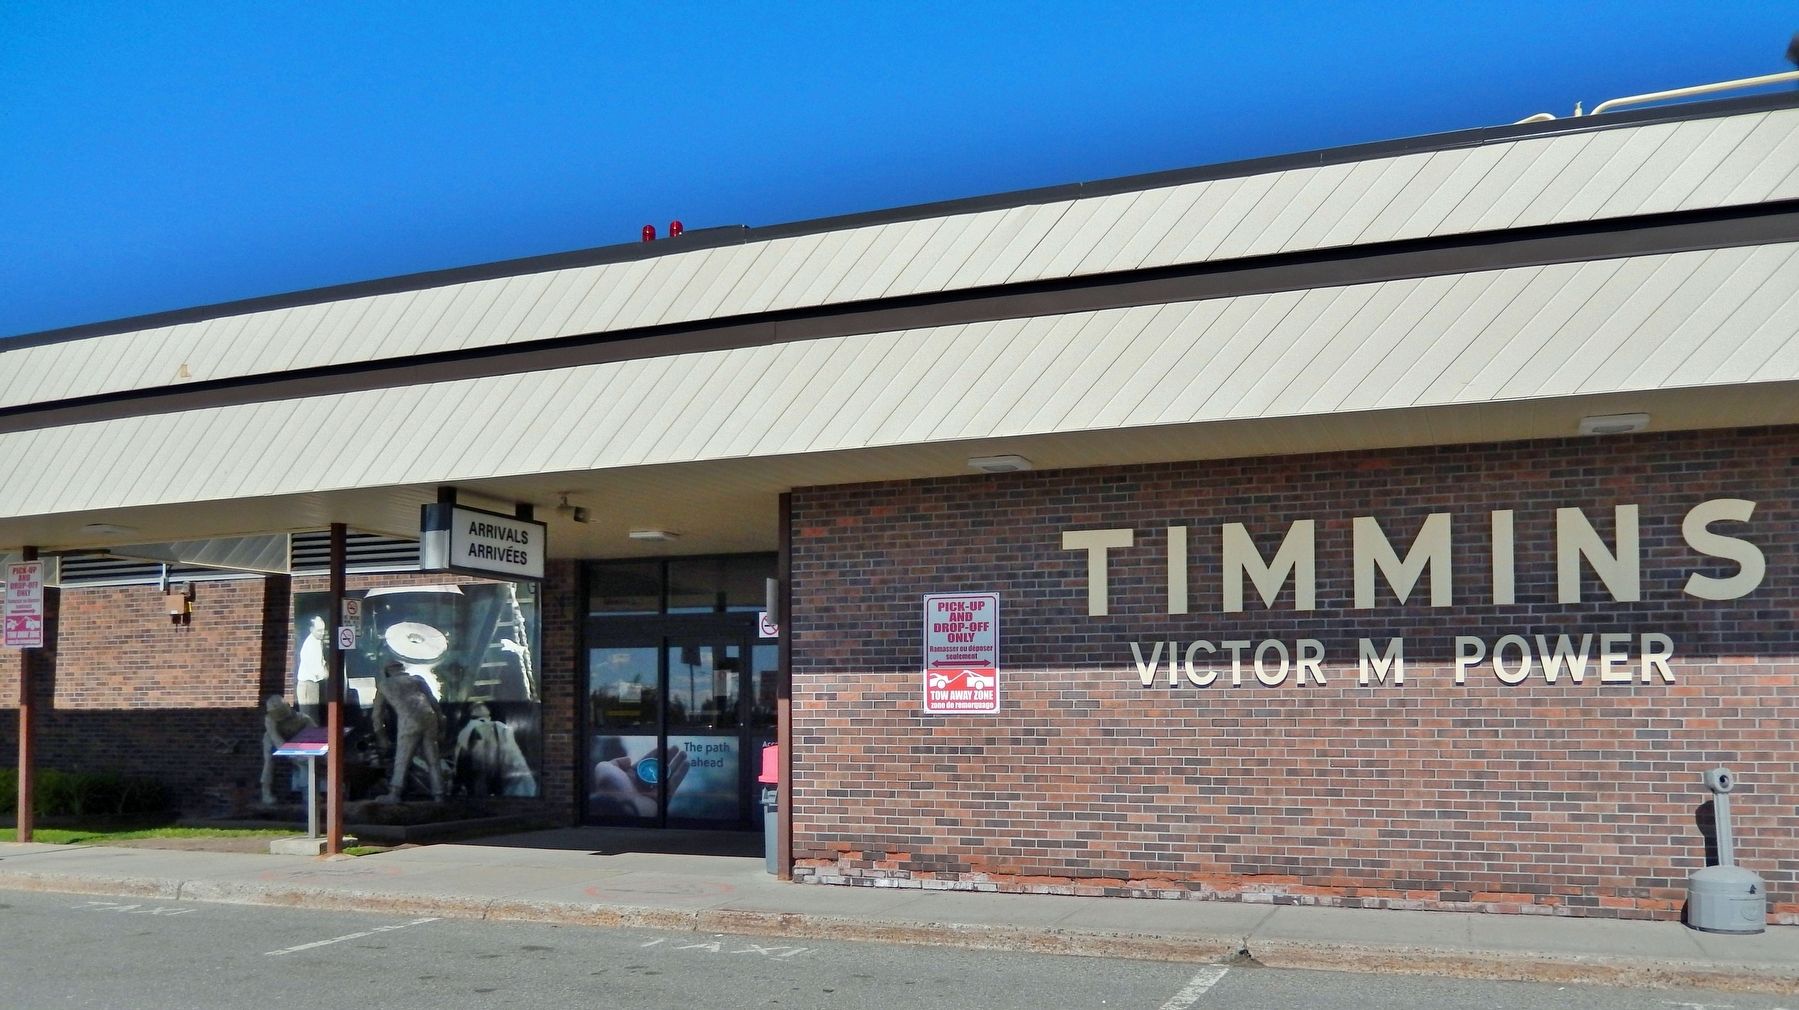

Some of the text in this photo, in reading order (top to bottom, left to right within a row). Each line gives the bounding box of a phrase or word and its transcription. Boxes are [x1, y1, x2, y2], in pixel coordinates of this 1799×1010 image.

[468, 521, 529, 545] ARRIVALS
[468, 543, 528, 565] ARRIVÉES
[1062, 498, 1766, 616] TIMMINS
[937, 601, 986, 612] PICK-UP
[949, 612, 973, 622] AND
[933, 622, 989, 633] DROP-OFF
[947, 633, 976, 643] ONLY
[929, 645, 959, 653] Ramasser
[1130, 633, 1676, 687] VICTOR M POWER
[930, 690, 994, 701] TOW AWAY ZONE
[955, 701, 994, 709] remorquage
[684, 742, 731, 755] The path
[690, 757, 724, 768] ahead
